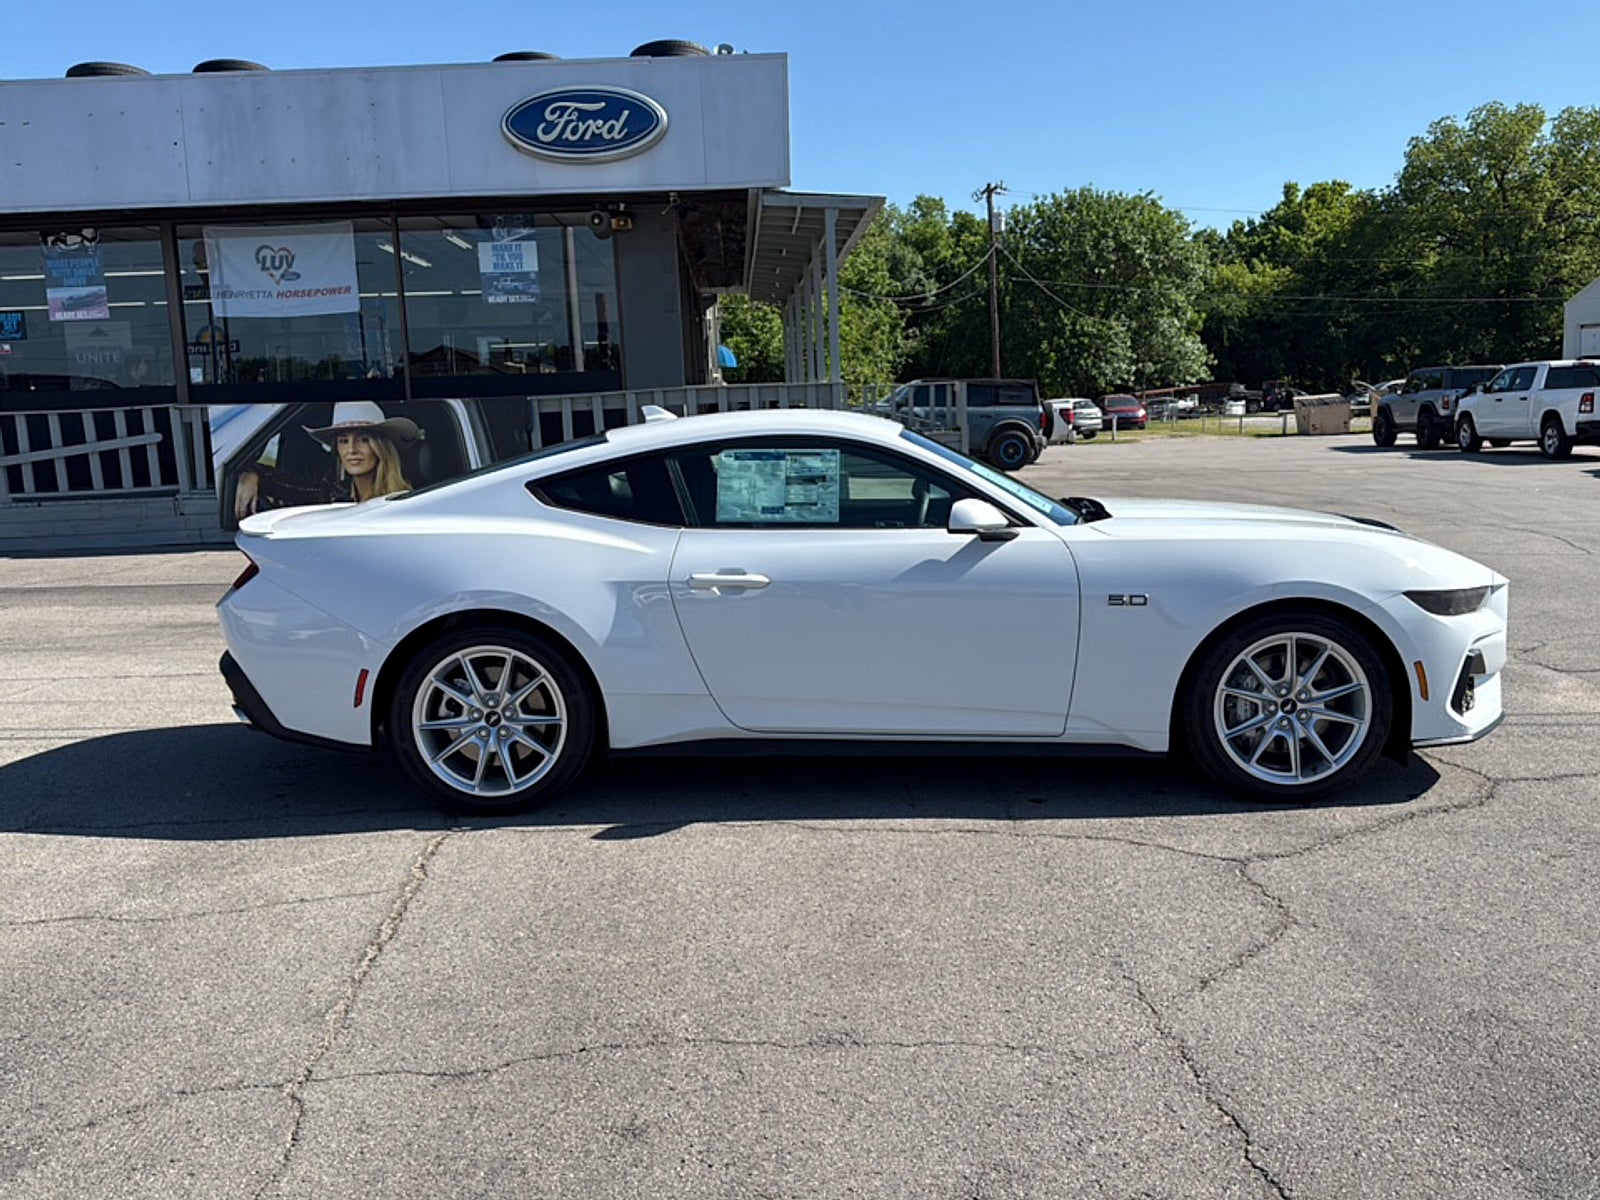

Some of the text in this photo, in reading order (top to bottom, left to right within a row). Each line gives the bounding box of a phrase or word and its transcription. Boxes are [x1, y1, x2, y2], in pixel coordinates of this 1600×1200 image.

[536, 101, 630, 143] Ford
[260, 253, 296, 271] LUV
[216, 289, 273, 299] HENRYETTA
[276, 285, 352, 299] HORSEPOWER
[75, 351, 121, 363] UNITE
